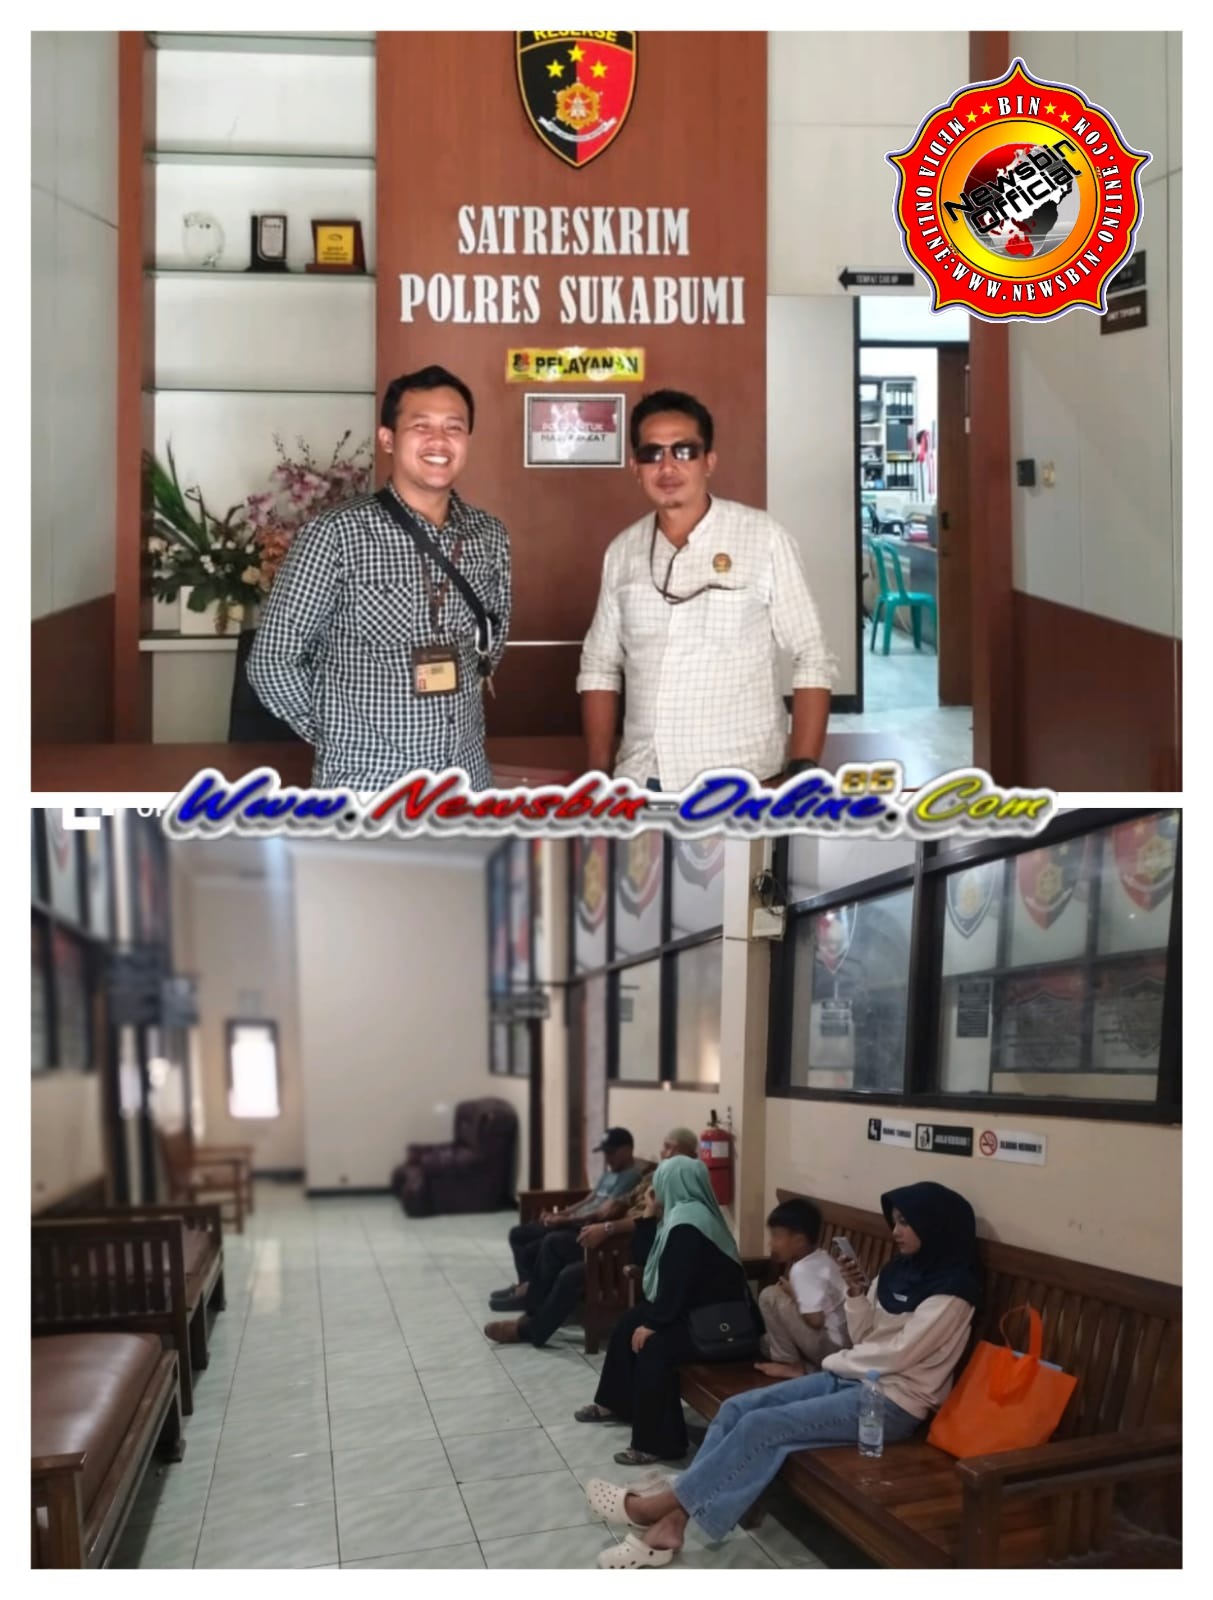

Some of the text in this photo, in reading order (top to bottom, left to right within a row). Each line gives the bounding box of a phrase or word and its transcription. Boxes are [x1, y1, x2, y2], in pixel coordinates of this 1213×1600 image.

[457, 205, 690, 256] SATRESKRIM
[399, 273, 746, 325] POLRES SUKABUMI
